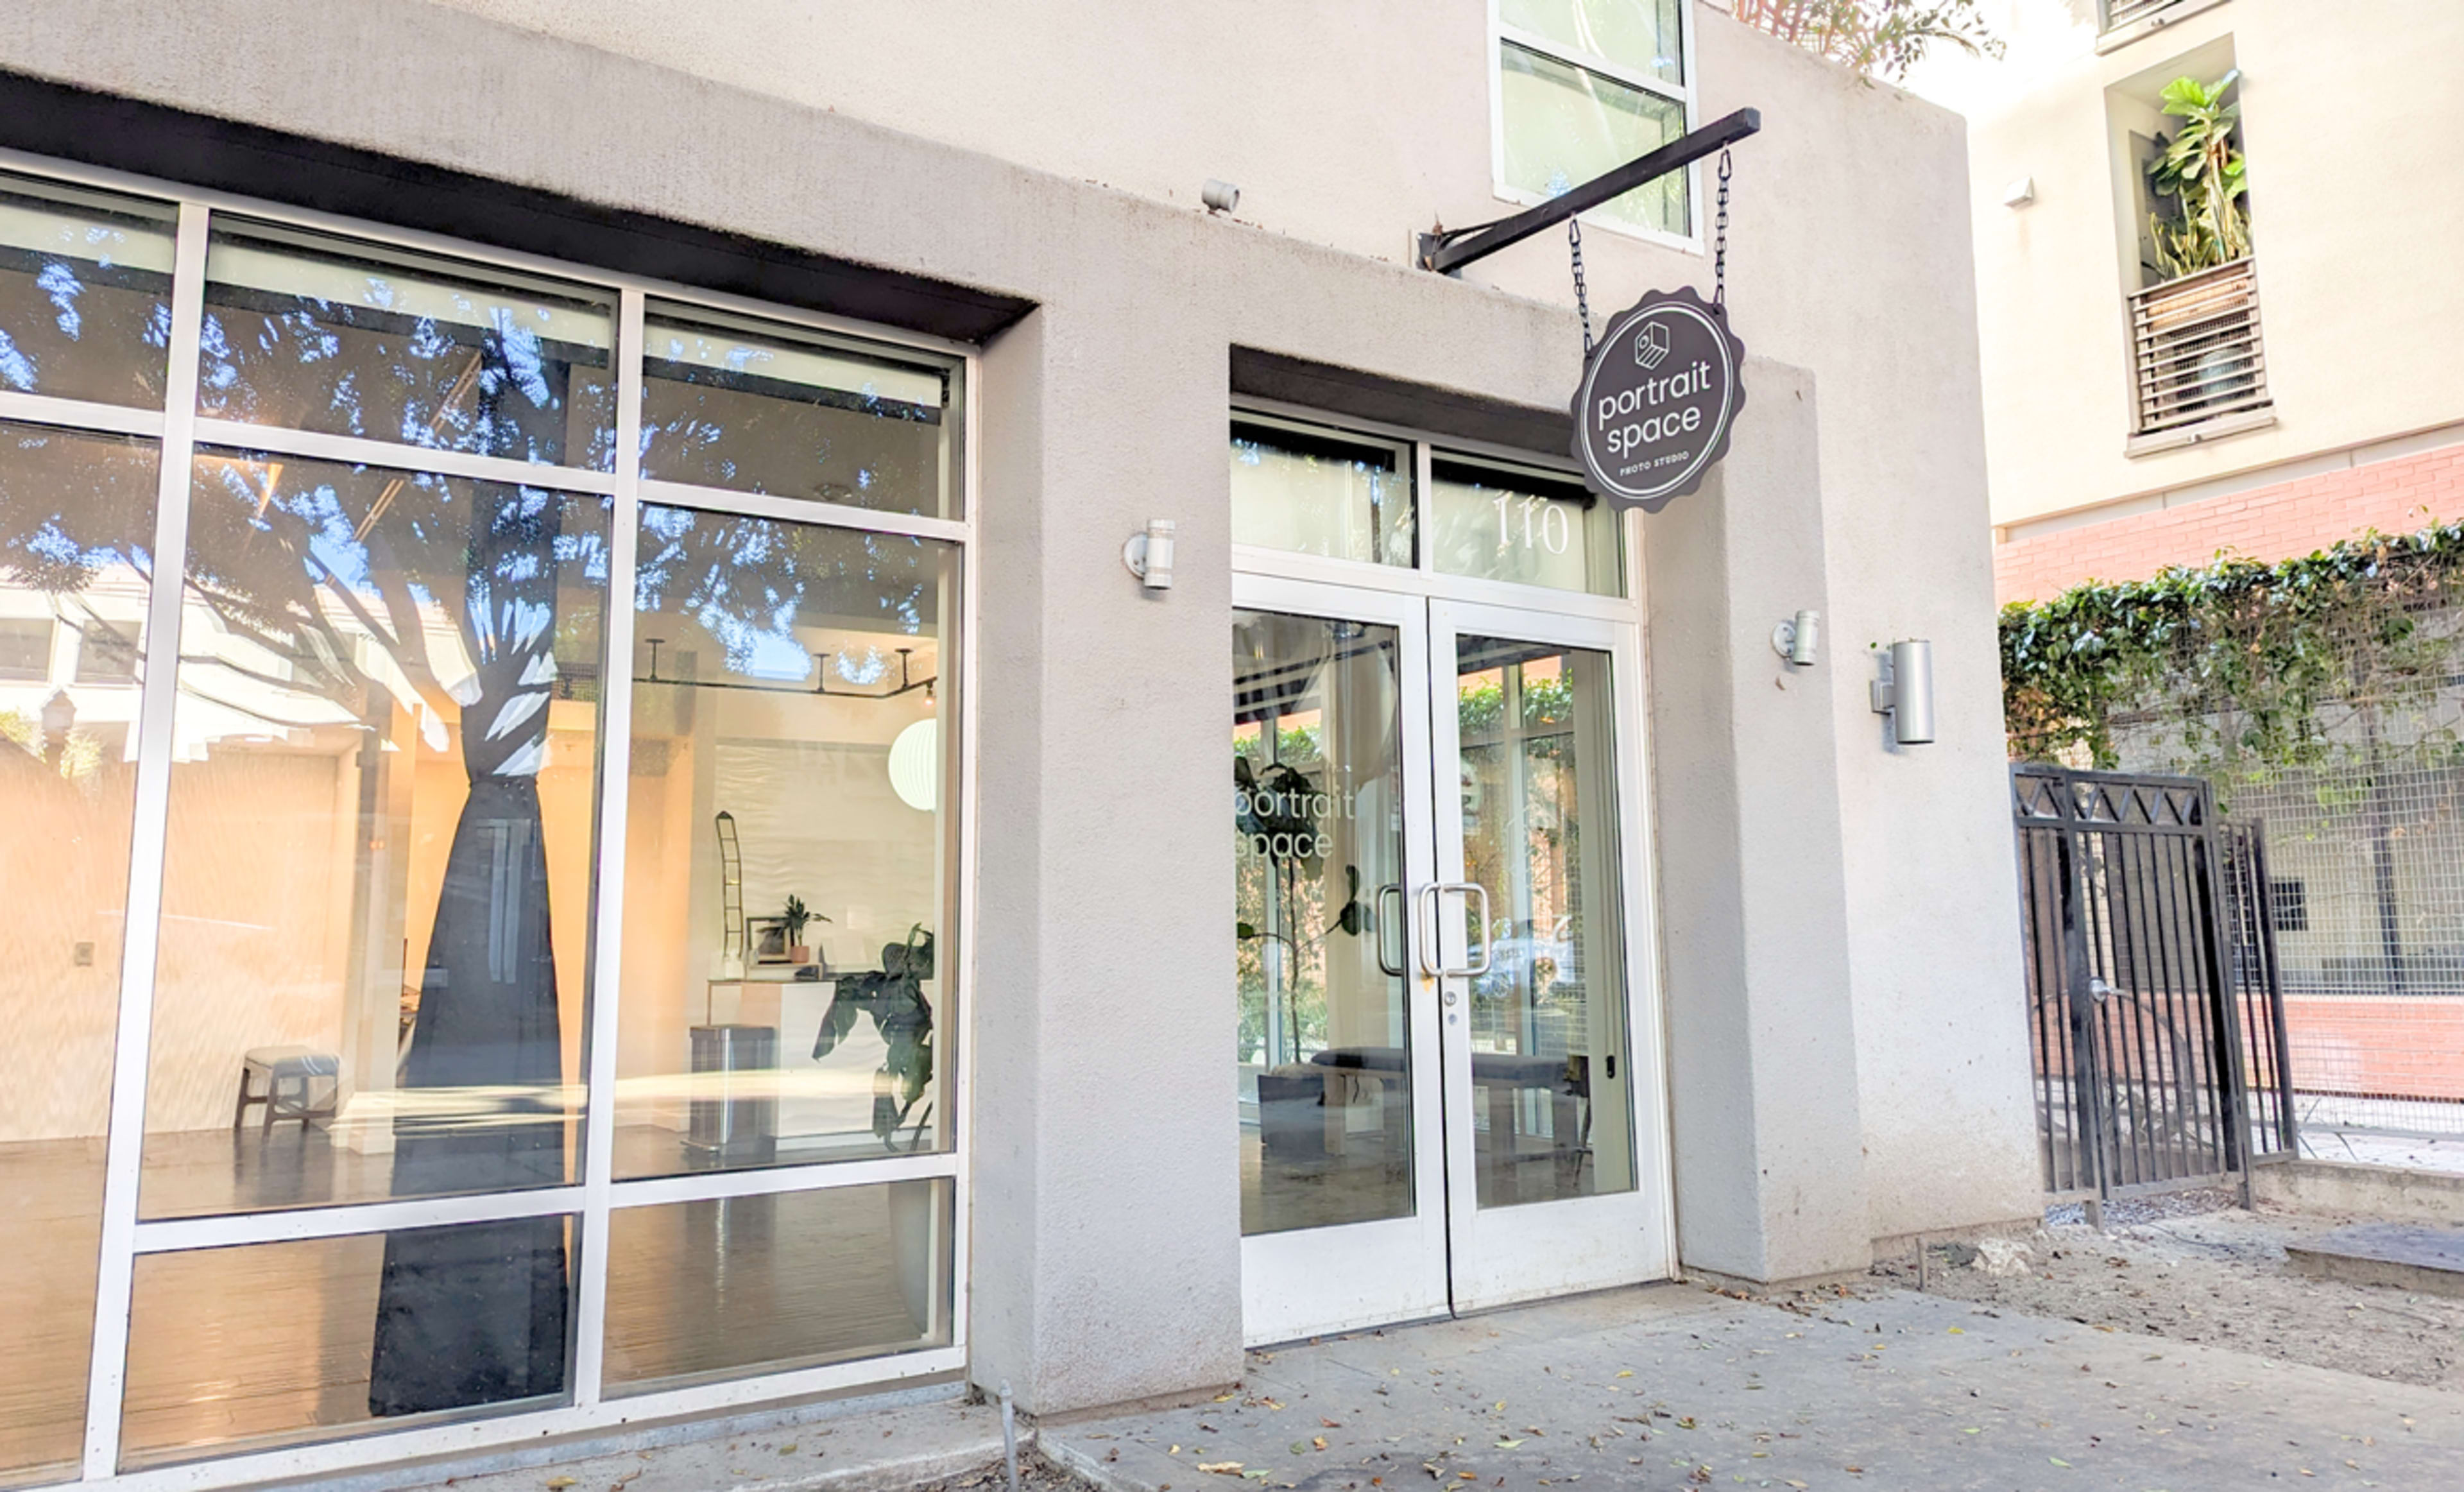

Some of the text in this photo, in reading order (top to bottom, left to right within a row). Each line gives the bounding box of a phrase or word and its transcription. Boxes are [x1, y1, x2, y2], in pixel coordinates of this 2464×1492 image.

[1598, 360, 1711, 431] portrait
[1607, 406, 1701, 459] space
[1620, 461, 1652, 476] PHOTO
[1493, 493, 1568, 554] 110
